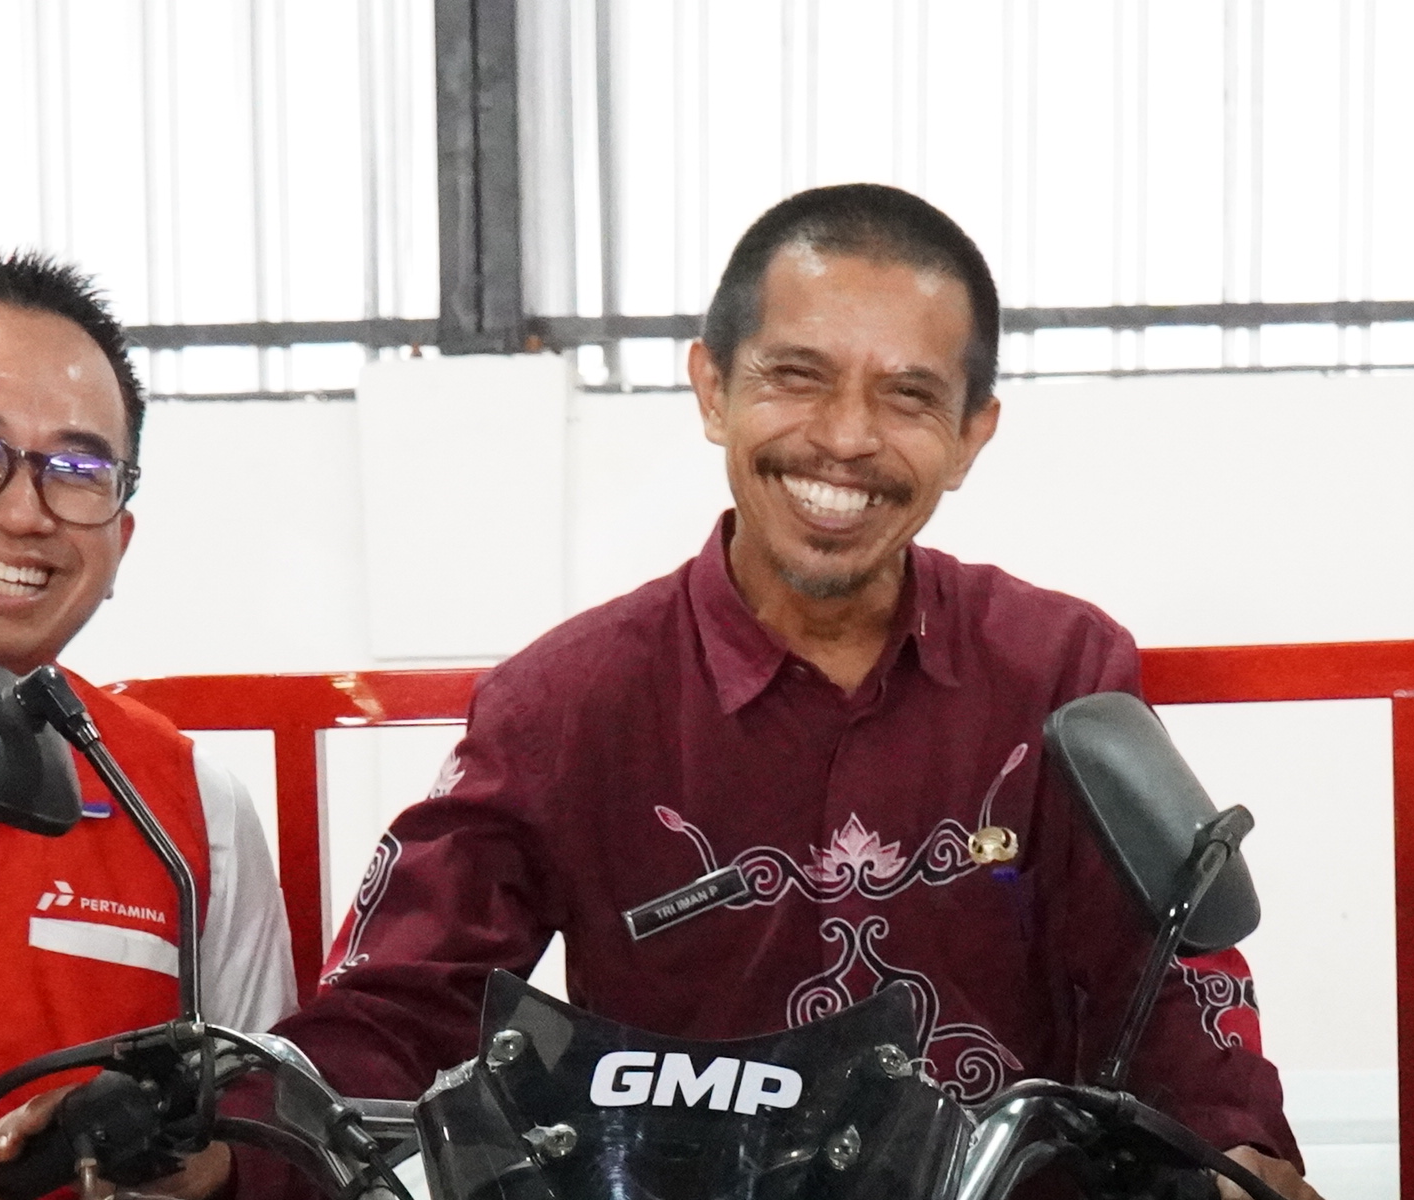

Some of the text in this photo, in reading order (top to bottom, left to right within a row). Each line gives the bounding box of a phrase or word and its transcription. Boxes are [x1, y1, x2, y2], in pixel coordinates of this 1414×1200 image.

[80, 896, 167, 924] PERTAMINA
[655, 902, 676, 919] TRI
[590, 1051, 803, 1115] GMP
